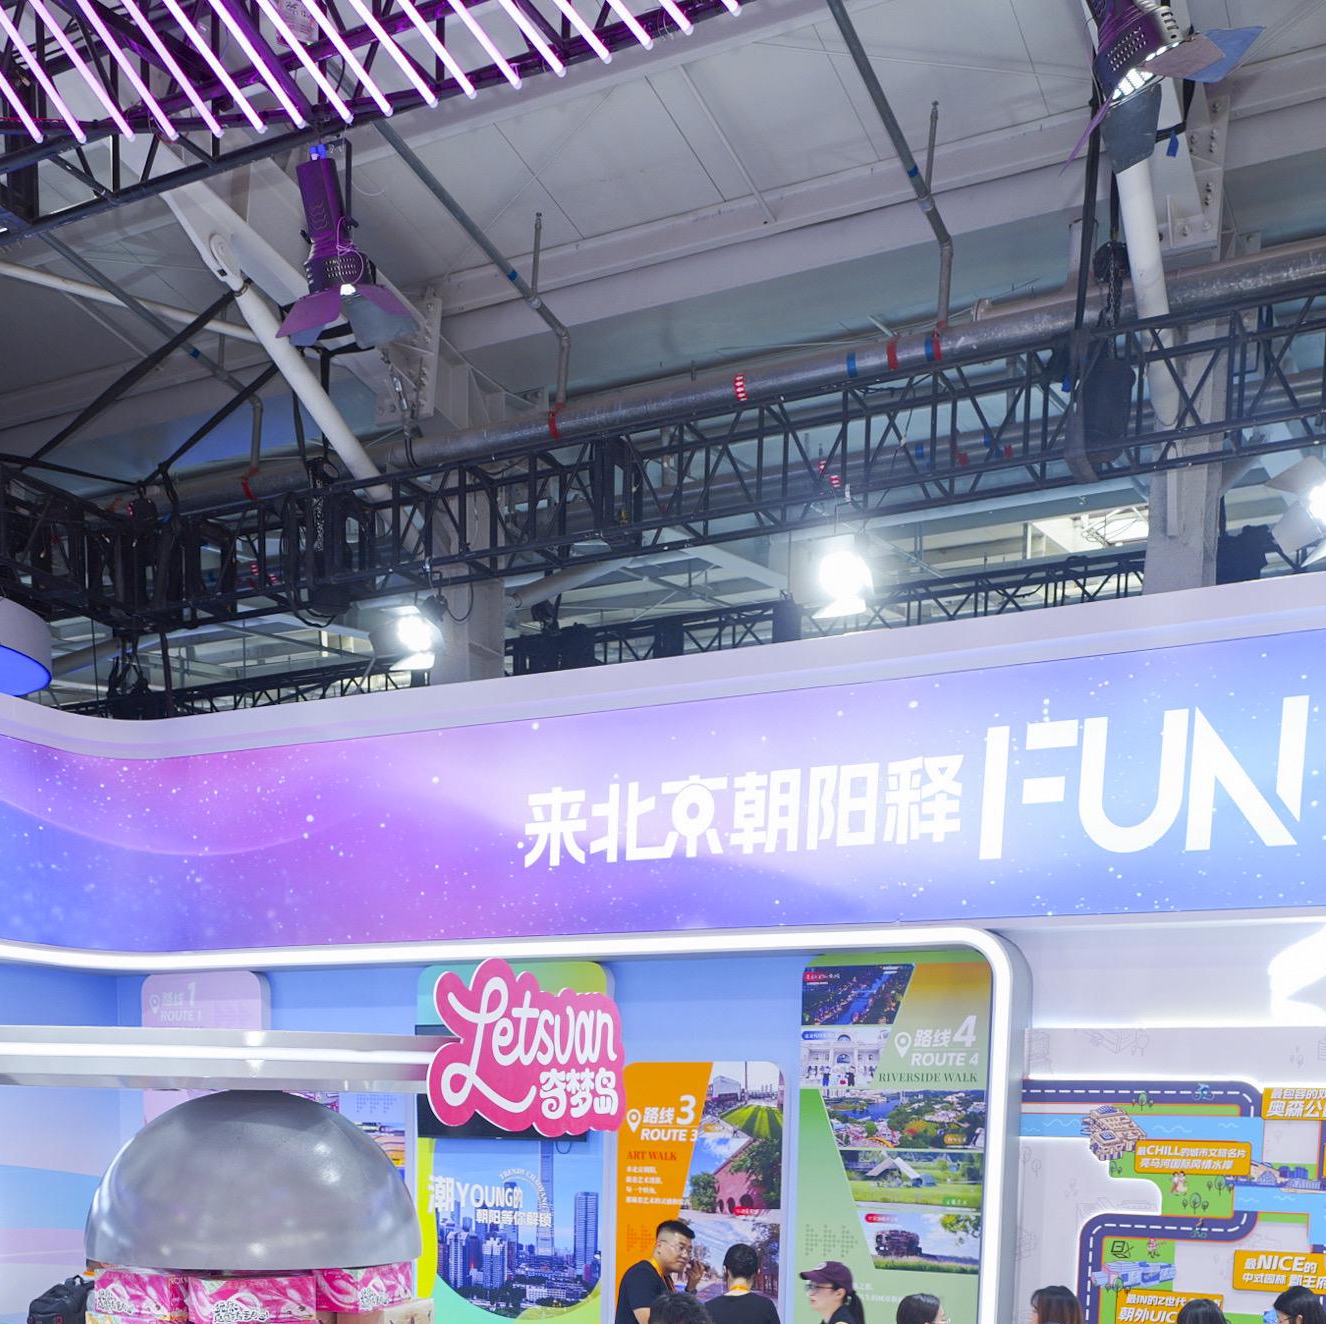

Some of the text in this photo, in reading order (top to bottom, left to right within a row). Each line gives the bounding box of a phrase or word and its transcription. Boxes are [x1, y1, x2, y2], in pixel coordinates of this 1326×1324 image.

[522, 752, 964, 868] 来北京朝阳释
[979, 694, 1312, 861] FUN
[911, 1052, 979, 1067] ROUTE 4
[878, 1072, 978, 1083] RIVERSIDE WALK
[539, 1068, 619, 1119] 奇梦岛
[640, 1128, 698, 1142] ROUTE 3
[626, 1151, 677, 1161] ART WALK
[1244, 1255, 1318, 1274] 最NICE的
